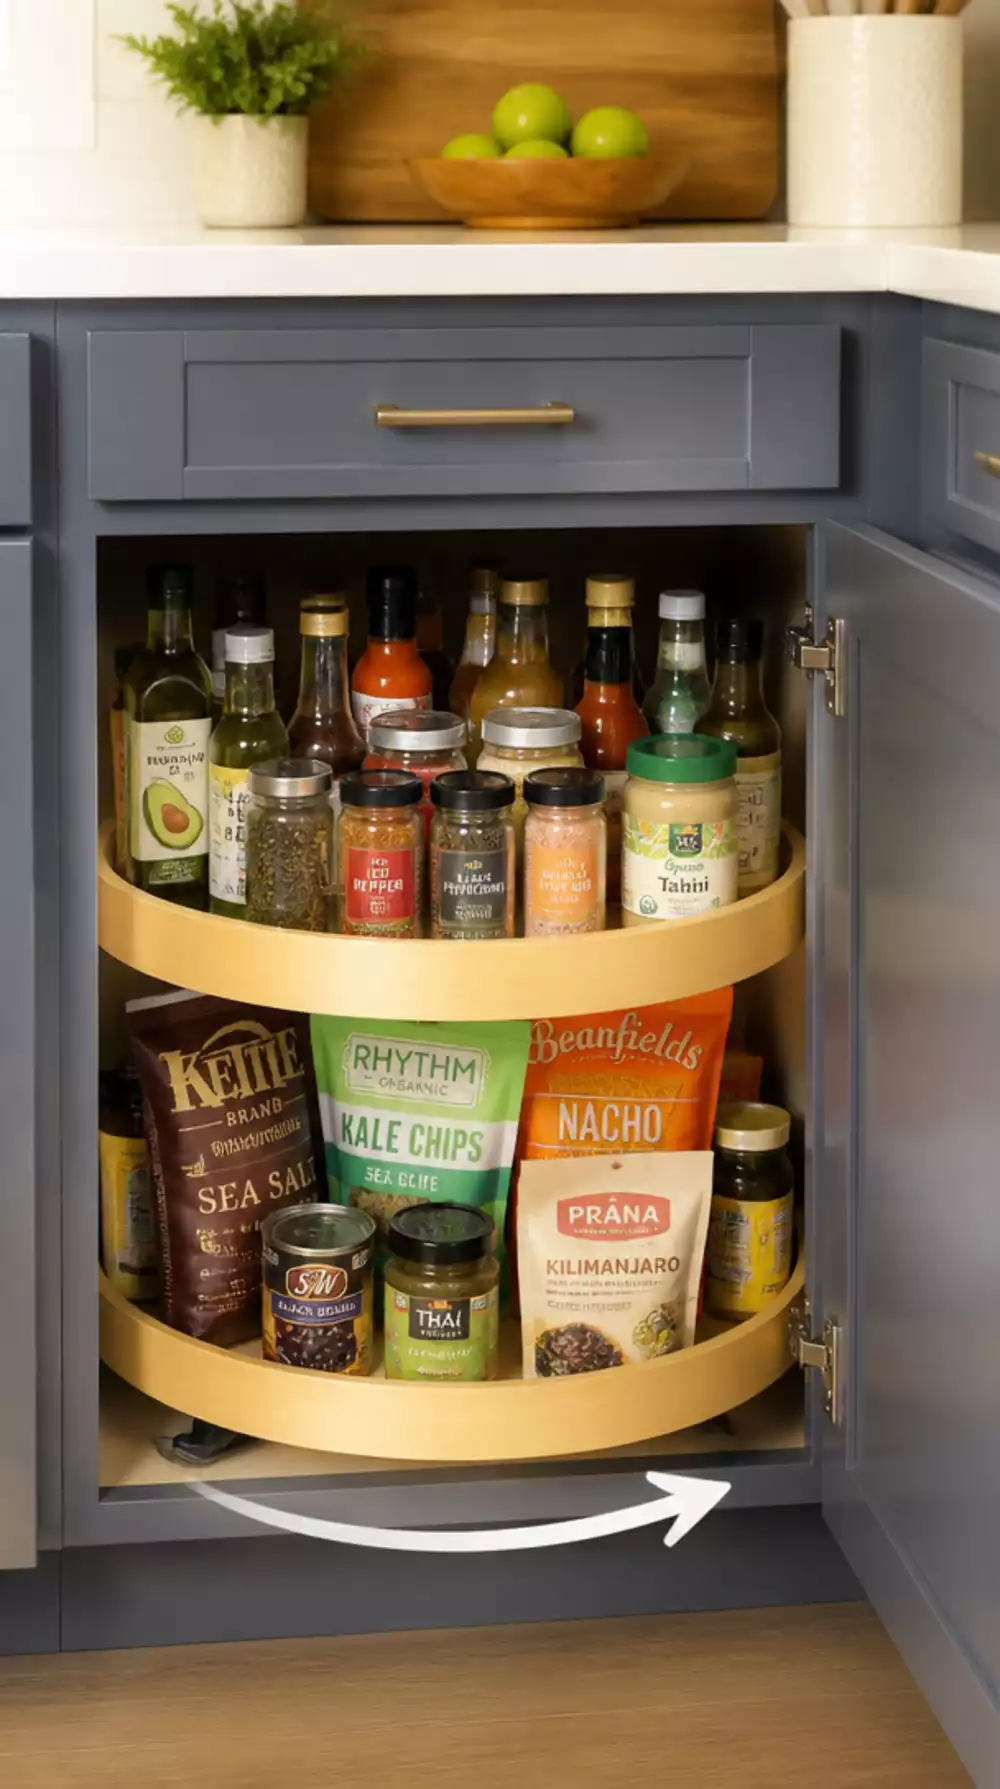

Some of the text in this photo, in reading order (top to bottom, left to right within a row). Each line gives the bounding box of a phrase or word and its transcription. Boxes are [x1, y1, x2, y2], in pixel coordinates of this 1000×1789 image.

[527, 1011, 703, 1070] Beanfields
[353, 1044, 476, 1085] RHYTHM
[341, 1112, 402, 1154] KALE
[408, 1123, 484, 1163] CHIPS
[558, 1101, 662, 1143] NACHO
[197, 1179, 262, 1215] SEA
[546, 1255, 681, 1276] KILIMANJARO
[416, 1308, 462, 1329] THAI
